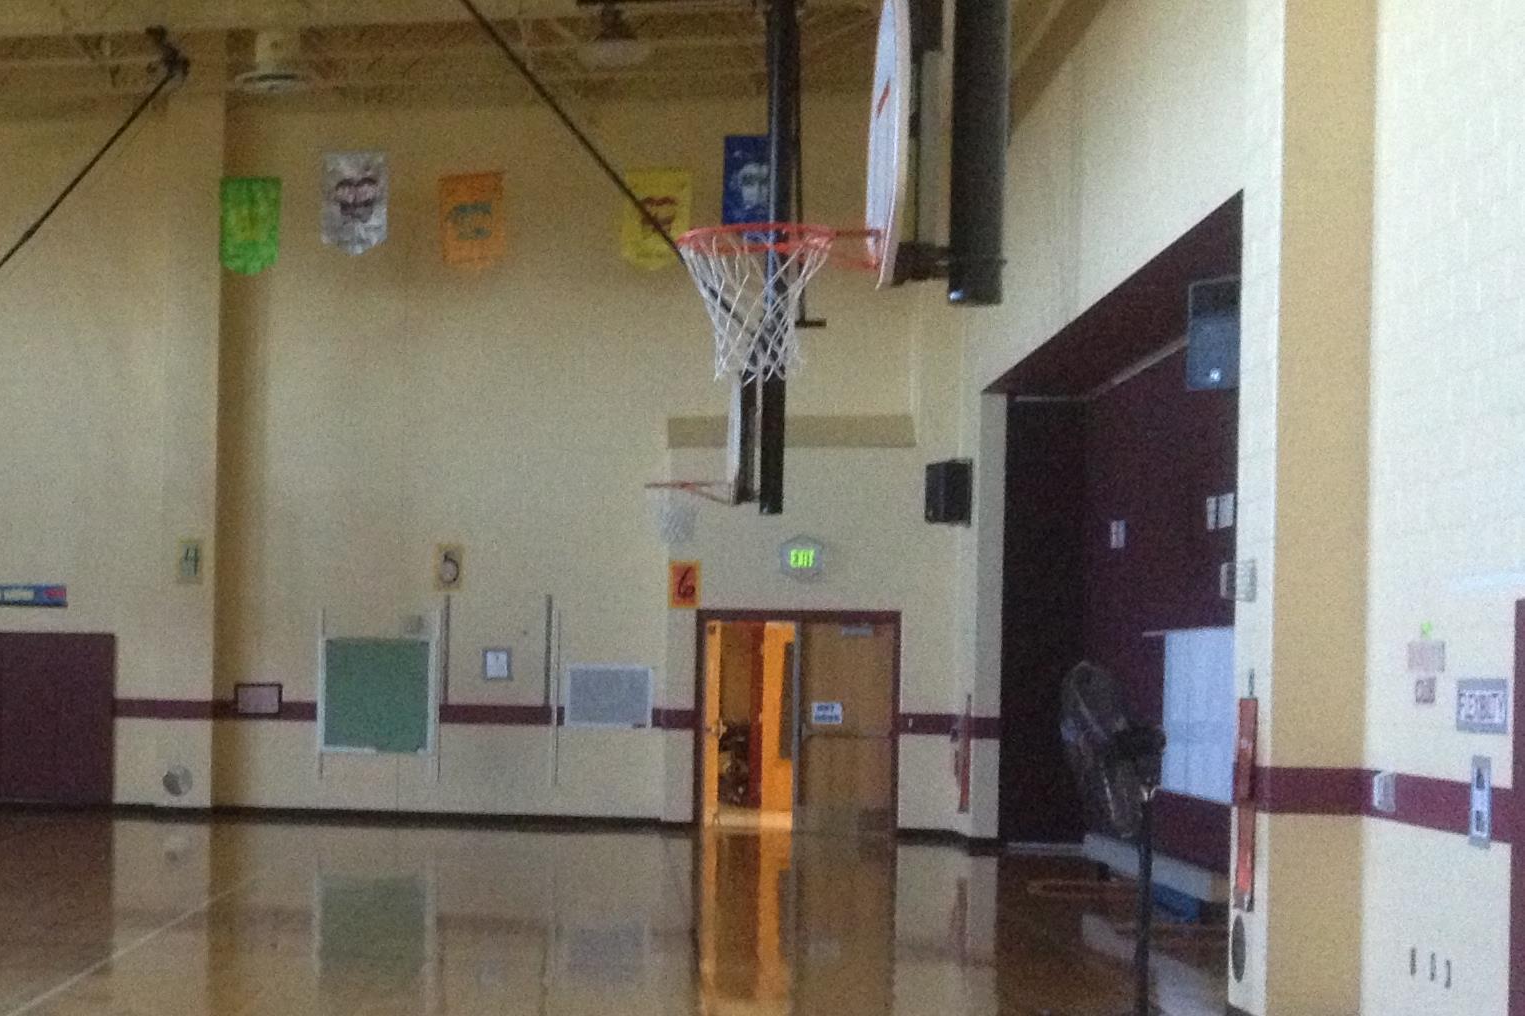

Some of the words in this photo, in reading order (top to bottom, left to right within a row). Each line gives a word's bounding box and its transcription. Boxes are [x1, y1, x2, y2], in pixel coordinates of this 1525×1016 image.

[183, 545, 199, 576] 4
[442, 550, 459, 584] 5
[790, 549, 815, 568] EXIT
[677, 566, 696, 598] 6
